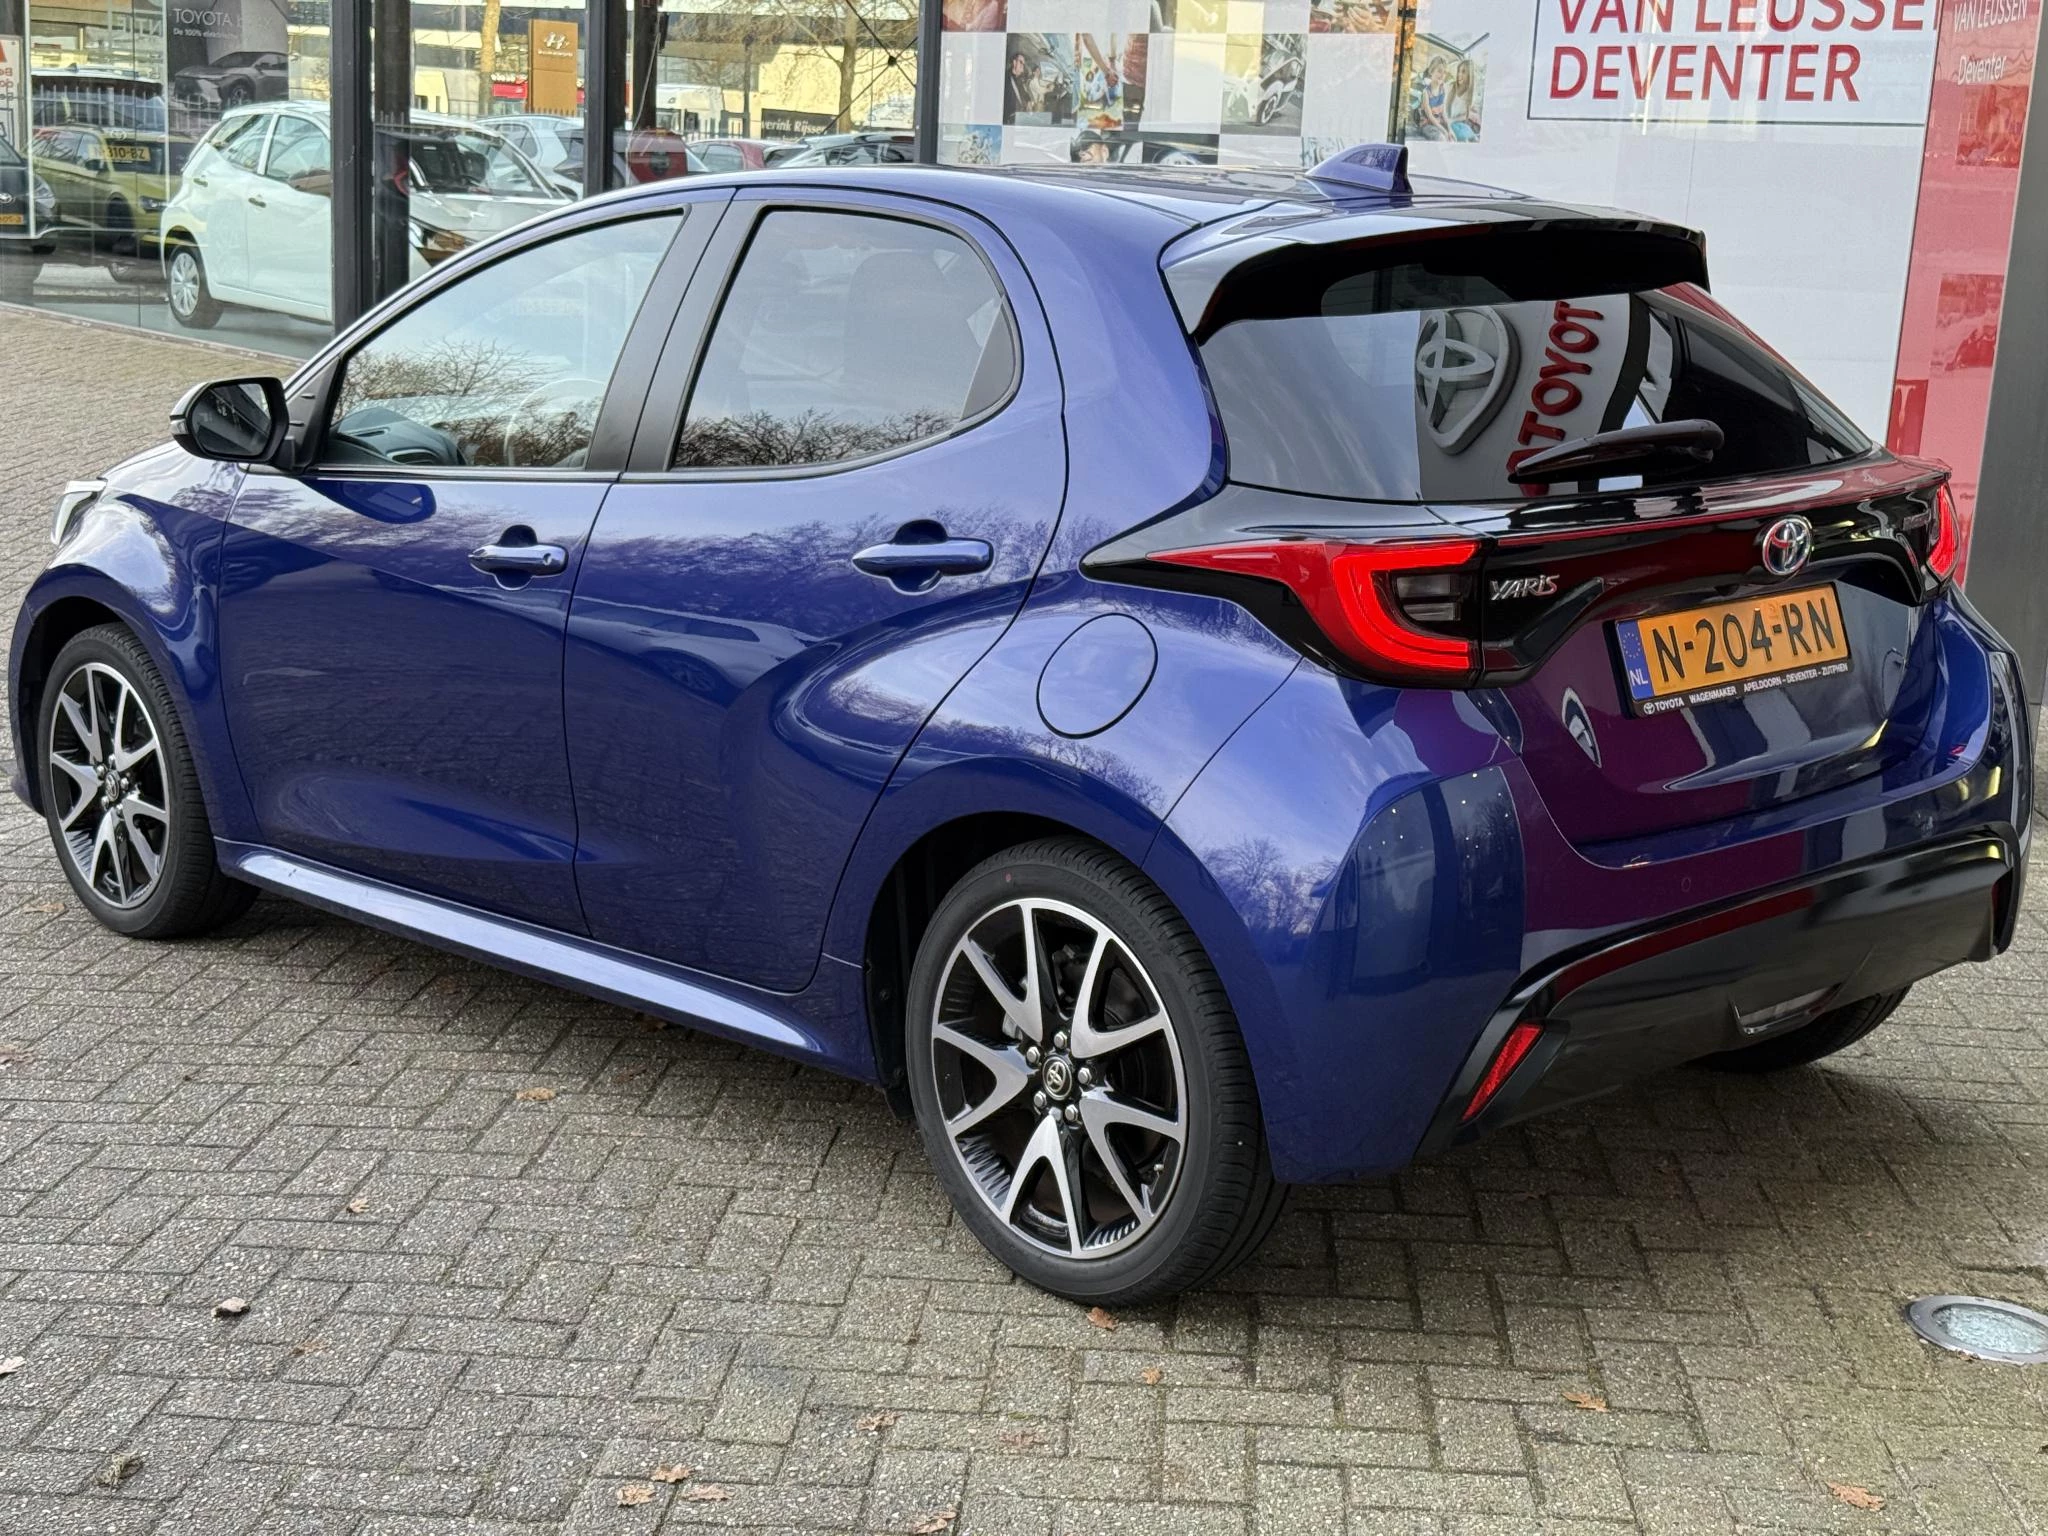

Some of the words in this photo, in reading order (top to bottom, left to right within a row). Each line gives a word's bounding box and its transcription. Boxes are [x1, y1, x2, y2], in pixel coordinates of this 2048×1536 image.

[171, 8, 233, 27] TOYOTA
[1557, 0, 1676, 34] VAN
[1694, 0, 1939, 33] LEUSSE
[1954, 2, 1977, 33] VAN
[1549, 44, 1861, 102] DEVENTER
[1958, 53, 2006, 86] Deventer
[1490, 574, 1560, 600] YARIS
[1652, 597, 1836, 682] N-204-RN
[1629, 668, 1649, 687] NL
[1654, 697, 1685, 712] TOYOTA
[1688, 685, 1737, 704] WAGENMAKER
[1743, 676, 1782, 693] APELDOORN
[1786, 668, 1818, 684] DEVENTER
[1822, 662, 1849, 677] ZUTPHEN
